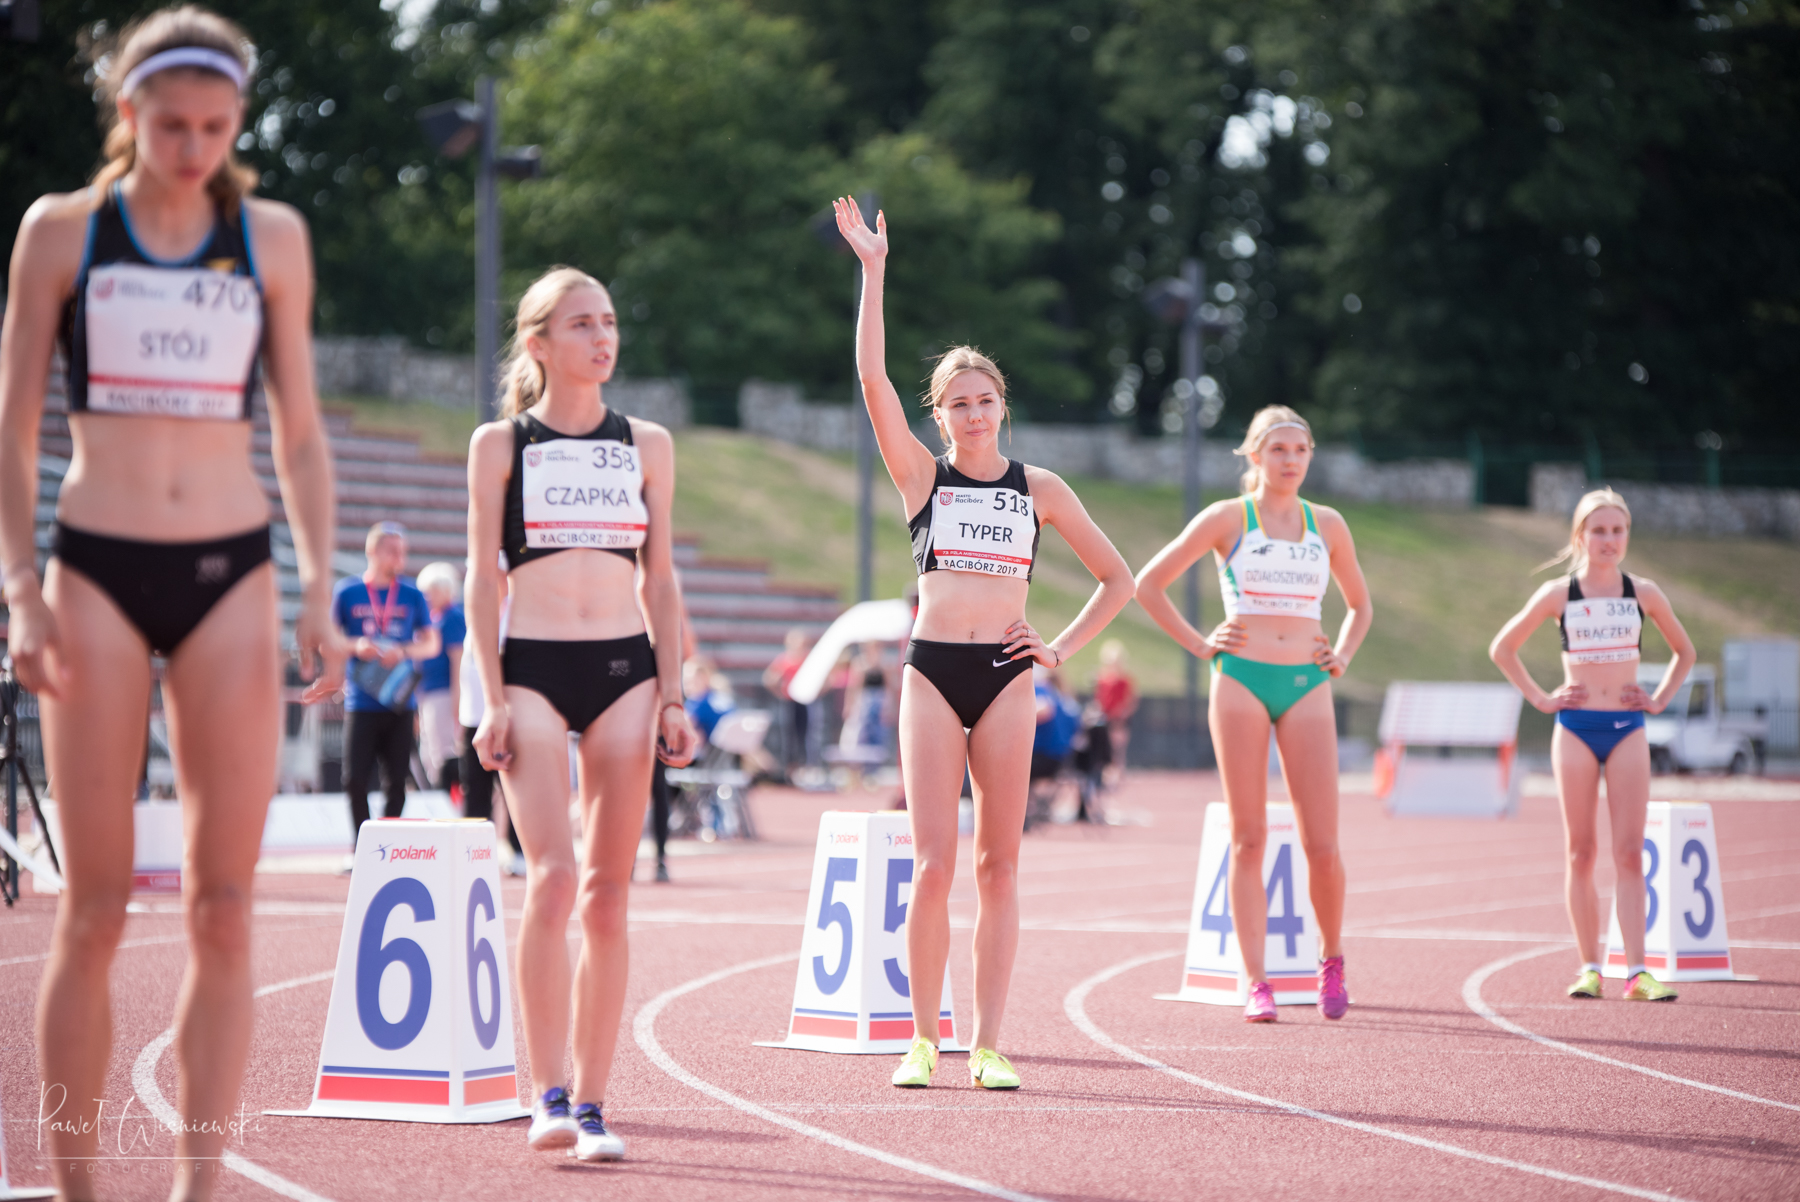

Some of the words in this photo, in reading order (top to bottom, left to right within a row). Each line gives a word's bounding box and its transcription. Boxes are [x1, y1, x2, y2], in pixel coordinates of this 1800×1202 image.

[182, 277, 248, 312] 470
[140, 327, 209, 362] STÓJ
[592, 446, 635, 472] 358
[545, 487, 630, 507] CZAPKA
[993, 491, 1029, 516] 518
[540, 529, 602, 544] RACIBÓRZ
[606, 534, 630, 545] 2019
[959, 522, 1013, 543] TYPER
[1289, 546, 1319, 561] 175
[944, 559, 995, 573] RACIBÓRZ
[997, 564, 1018, 575] 2019
[1606, 602, 1636, 616] 336
[389, 845, 438, 863] polanik
[471, 846, 491, 863] polanik
[1201, 843, 1233, 956] 4
[1266, 844, 1304, 957] 4
[1681, 839, 1715, 939] 3
[812, 857, 858, 996] 5
[355, 877, 436, 1050] 6
[466, 877, 500, 1050] 6
